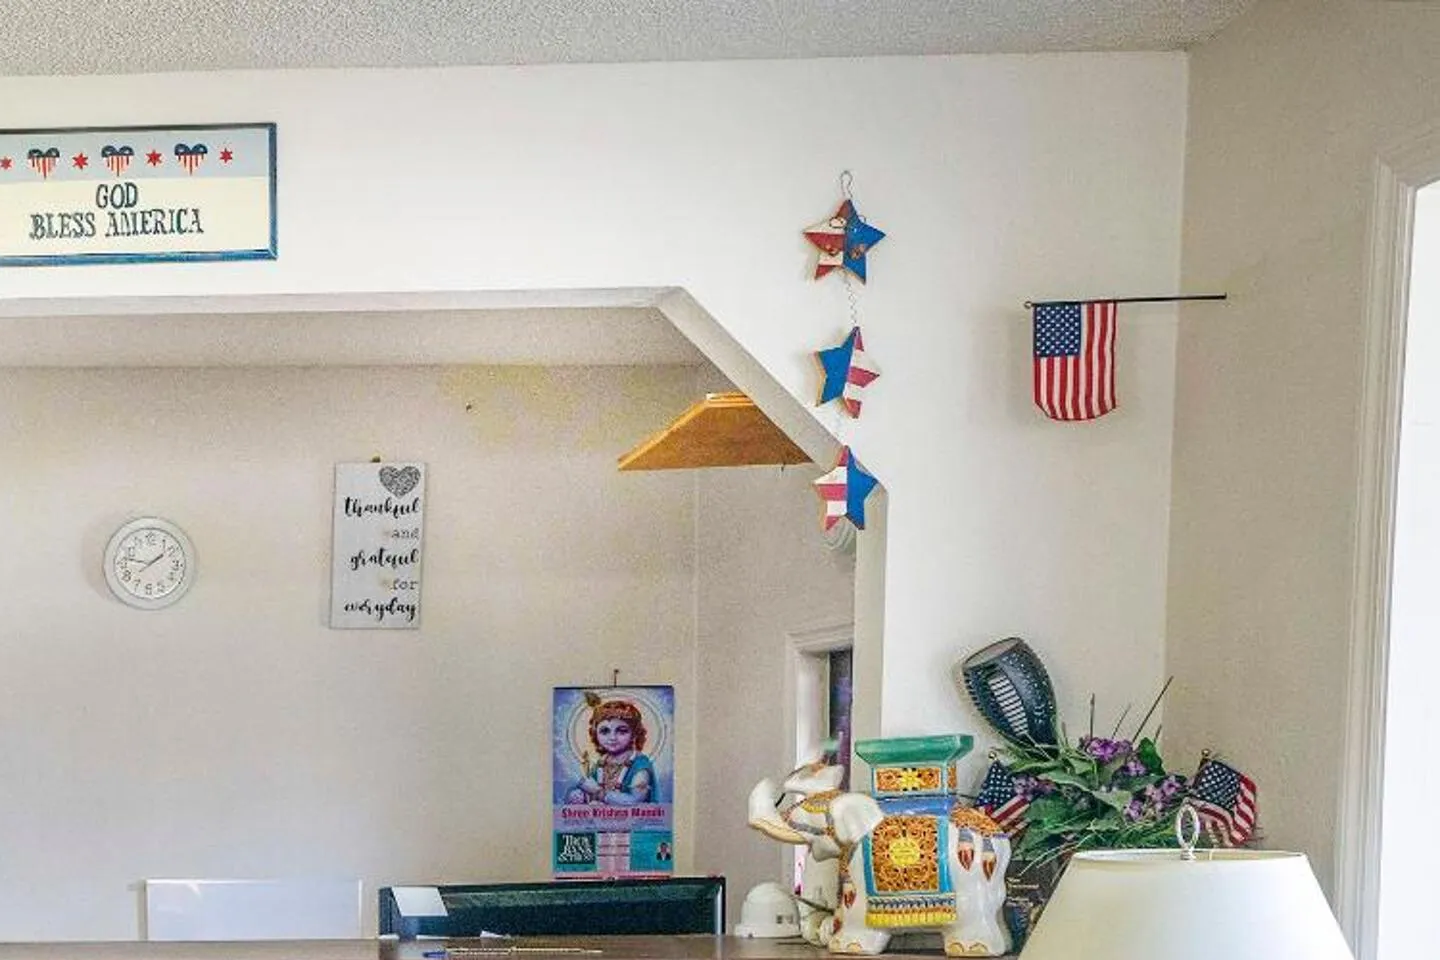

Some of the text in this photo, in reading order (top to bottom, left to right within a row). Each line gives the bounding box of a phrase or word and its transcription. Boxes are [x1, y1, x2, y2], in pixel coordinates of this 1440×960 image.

[96, 182, 138, 209] GOD
[29, 208, 204, 240] BLESS AMERICA
[344, 496, 420, 519] thankful
[350, 547, 419, 571] grateful
[343, 597, 417, 622] everyday
